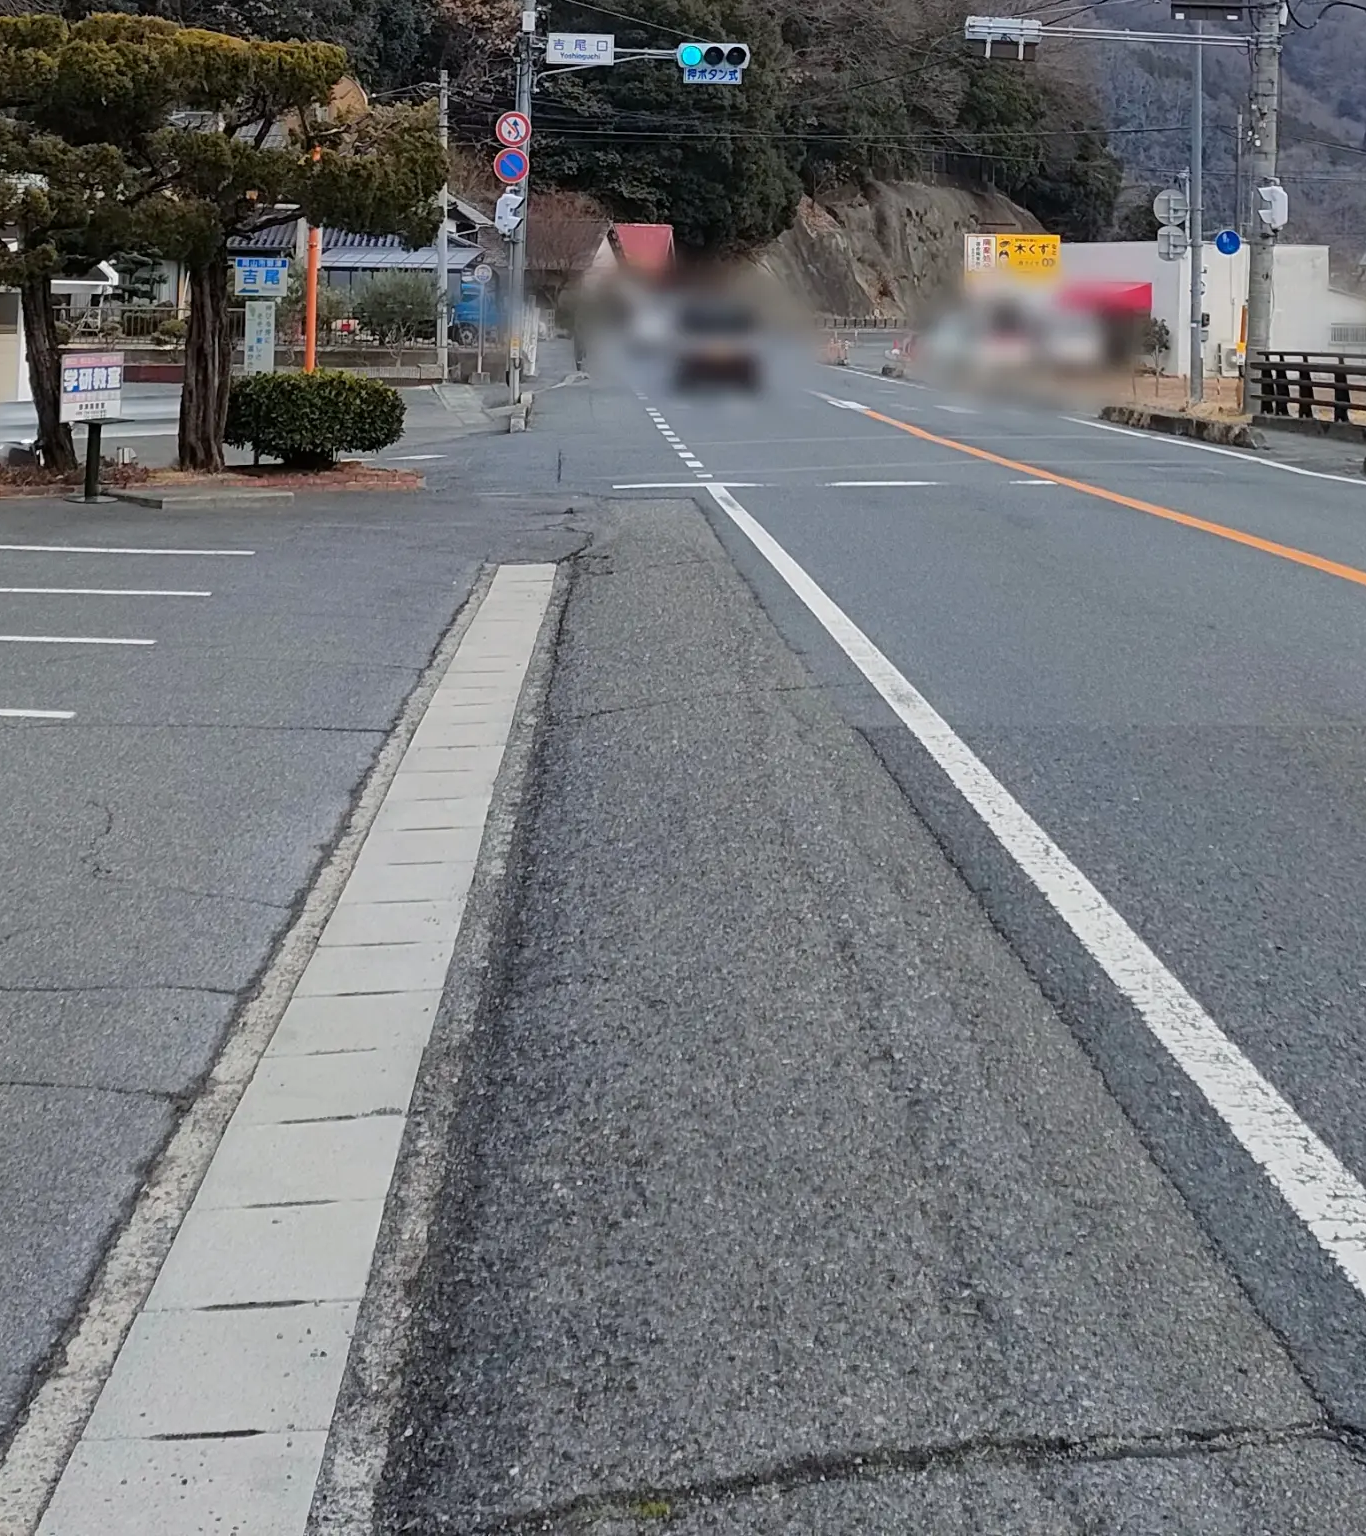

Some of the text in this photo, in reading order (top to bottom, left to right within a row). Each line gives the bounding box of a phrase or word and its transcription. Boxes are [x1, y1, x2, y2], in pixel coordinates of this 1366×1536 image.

[553, 39, 608, 52] 吉尾口
[560, 52, 601, 60] Yoshioguchi
[687, 68, 738, 81] 押ボタン式
[243, 269, 280, 285] 吉尾
[64, 367, 121, 391] 学研教室
